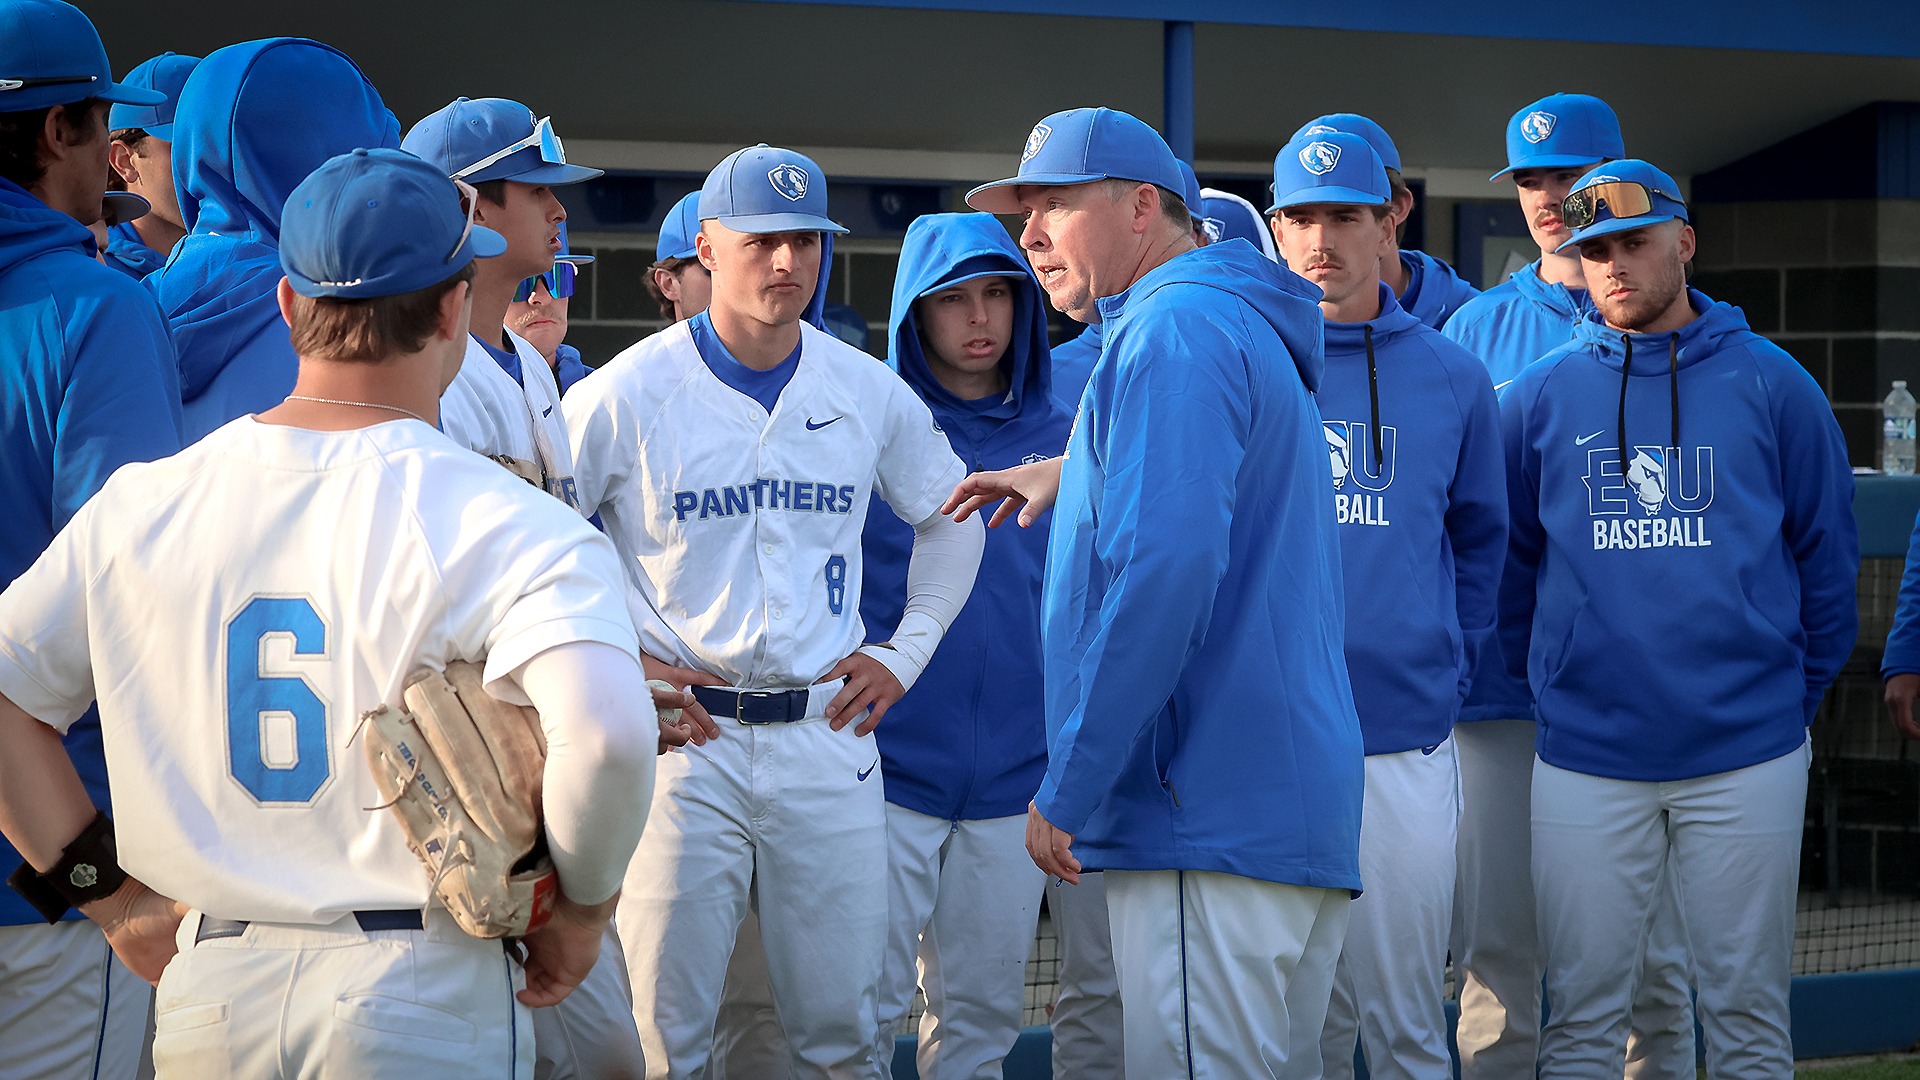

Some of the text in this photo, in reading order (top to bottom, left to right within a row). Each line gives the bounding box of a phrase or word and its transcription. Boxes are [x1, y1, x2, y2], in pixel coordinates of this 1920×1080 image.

[672, 478, 855, 523] PANTHERS
[1334, 493, 1390, 526] BALL
[1593, 516, 1712, 550] BASEBALL
[825, 553, 847, 618] 8
[223, 592, 337, 809] 6
[407, 758, 426, 782] GD
